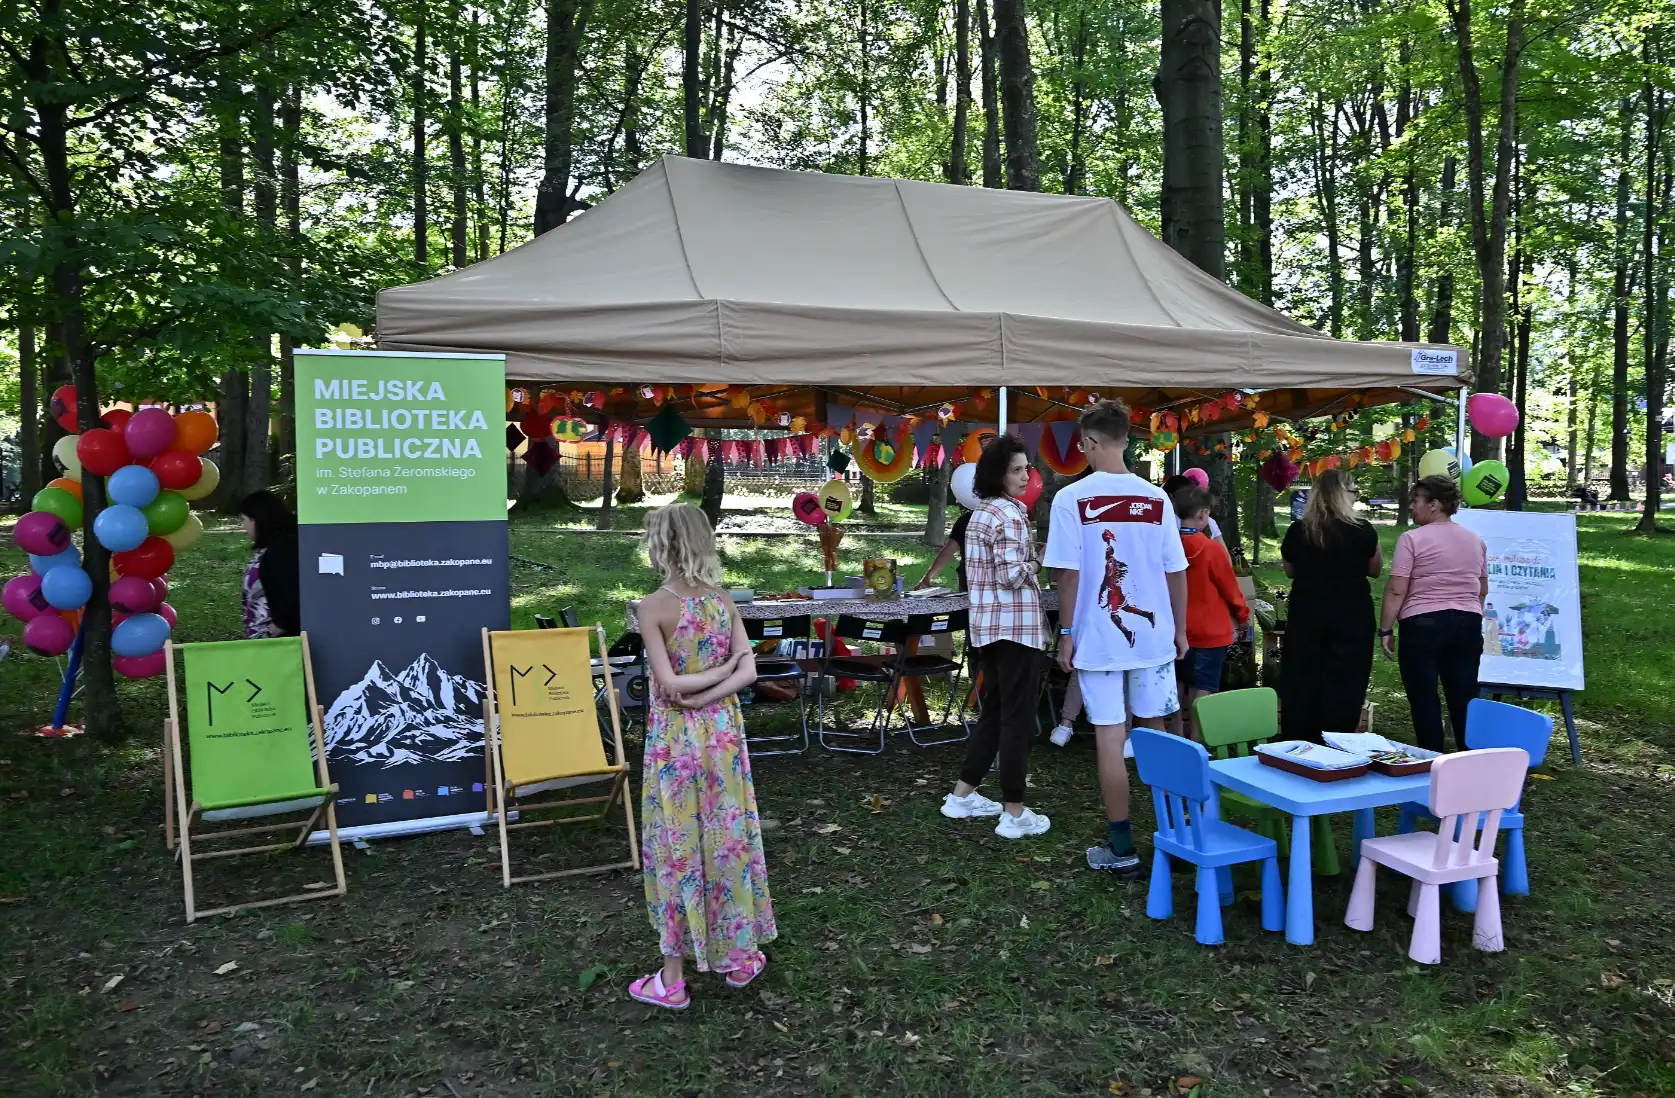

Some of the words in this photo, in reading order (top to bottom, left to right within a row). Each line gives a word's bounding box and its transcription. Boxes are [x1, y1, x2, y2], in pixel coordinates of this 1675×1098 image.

[314, 379, 447, 401] MIEJSKA
[315, 408, 489, 430] BIBLIOTEKA
[315, 438, 482, 459] PUBLICZNA
[316, 467, 335, 478] im.
[338, 466, 391, 478] Stefana
[394, 465, 476, 480] Żeromskiego
[316, 486, 327, 495] w
[331, 484, 408, 497] Zakopanem
[1129, 502, 1153, 510] JORDAN
[1129, 508, 1144, 516] NIKE
[370, 558, 493, 570] mbp@biblioteka.zakopane.eu
[1511, 565, 1556, 579] CZYTANIA
[371, 588, 492, 600] www.biblioteka.zakopane.eu
